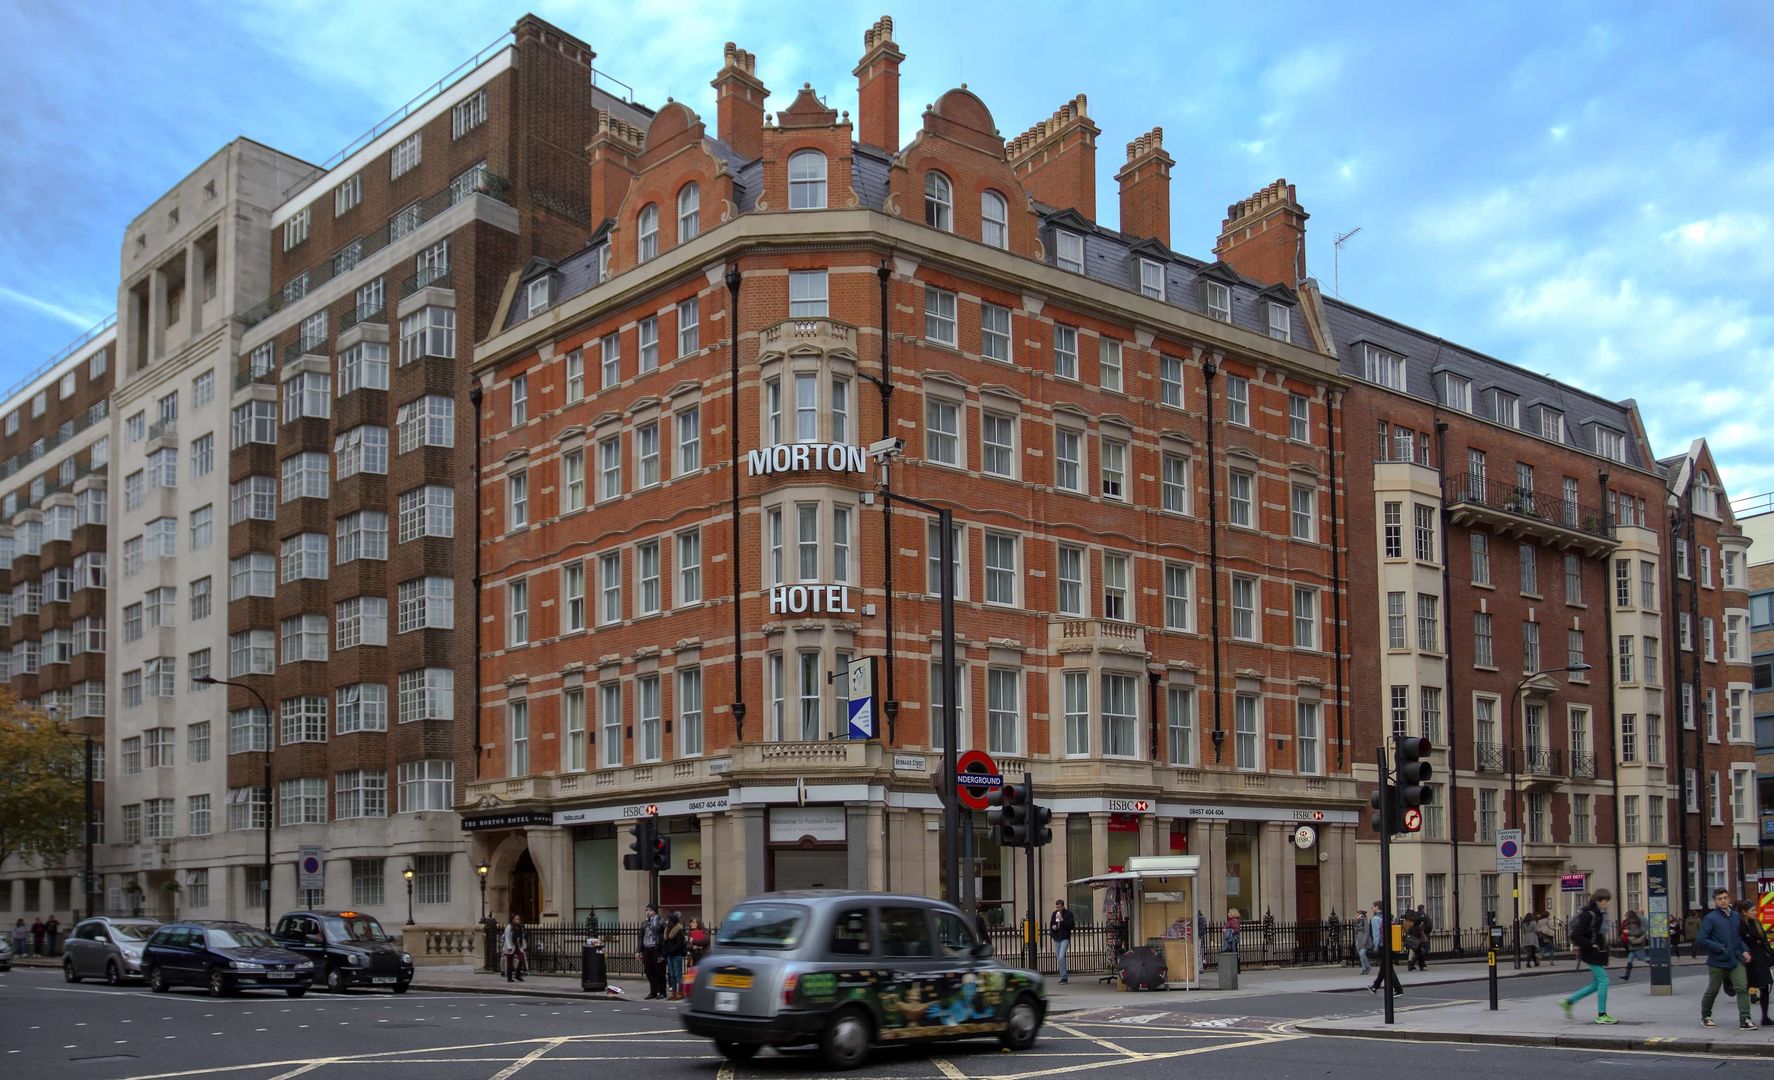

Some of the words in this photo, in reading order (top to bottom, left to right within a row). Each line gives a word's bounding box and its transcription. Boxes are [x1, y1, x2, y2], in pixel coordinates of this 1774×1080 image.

[748, 443, 867, 477] MORTON
[769, 585, 856, 614] HOTEL
[895, 758, 911, 767] BERNARD
[957, 775, 1001, 785] NDERGROUND
[688, 802, 705, 811] 08457
[706, 801, 717, 809] 404
[717, 799, 728, 808] 404
[1109, 800, 1134, 811] HSBC
[623, 805, 644, 818] HSBC
[1293, 810, 1313, 819] HSBC
[479, 818, 505, 827] MORTON
[507, 816, 529, 824] HOTEL
